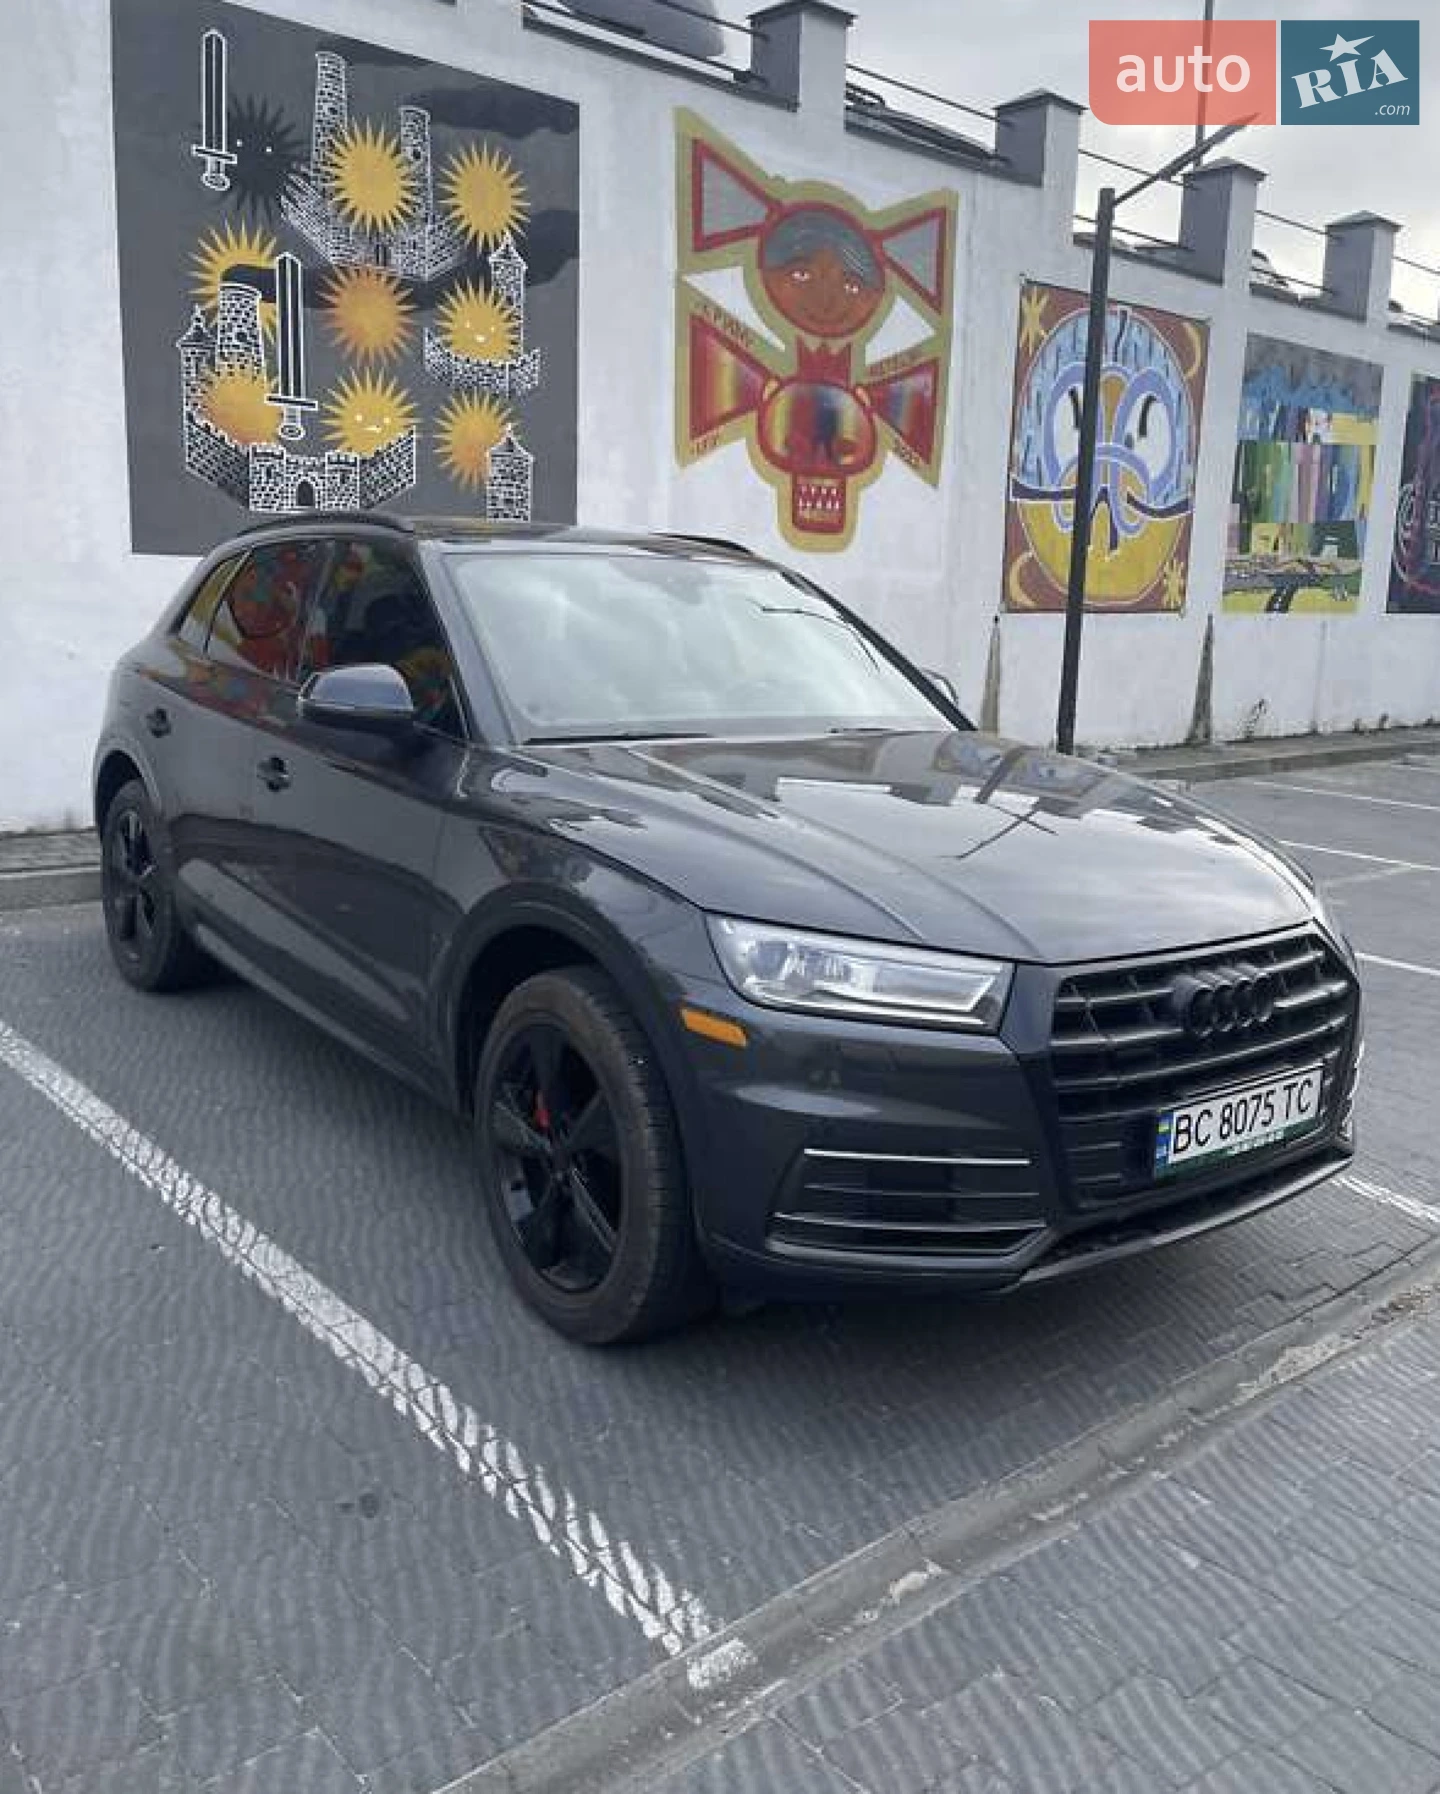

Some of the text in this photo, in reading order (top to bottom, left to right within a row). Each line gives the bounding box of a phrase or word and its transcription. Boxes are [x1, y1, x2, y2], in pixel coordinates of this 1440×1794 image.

[1173, 1109, 1213, 1154] BC
[1219, 1090, 1276, 1140] 8075
[1283, 1077, 1313, 1120] TC
